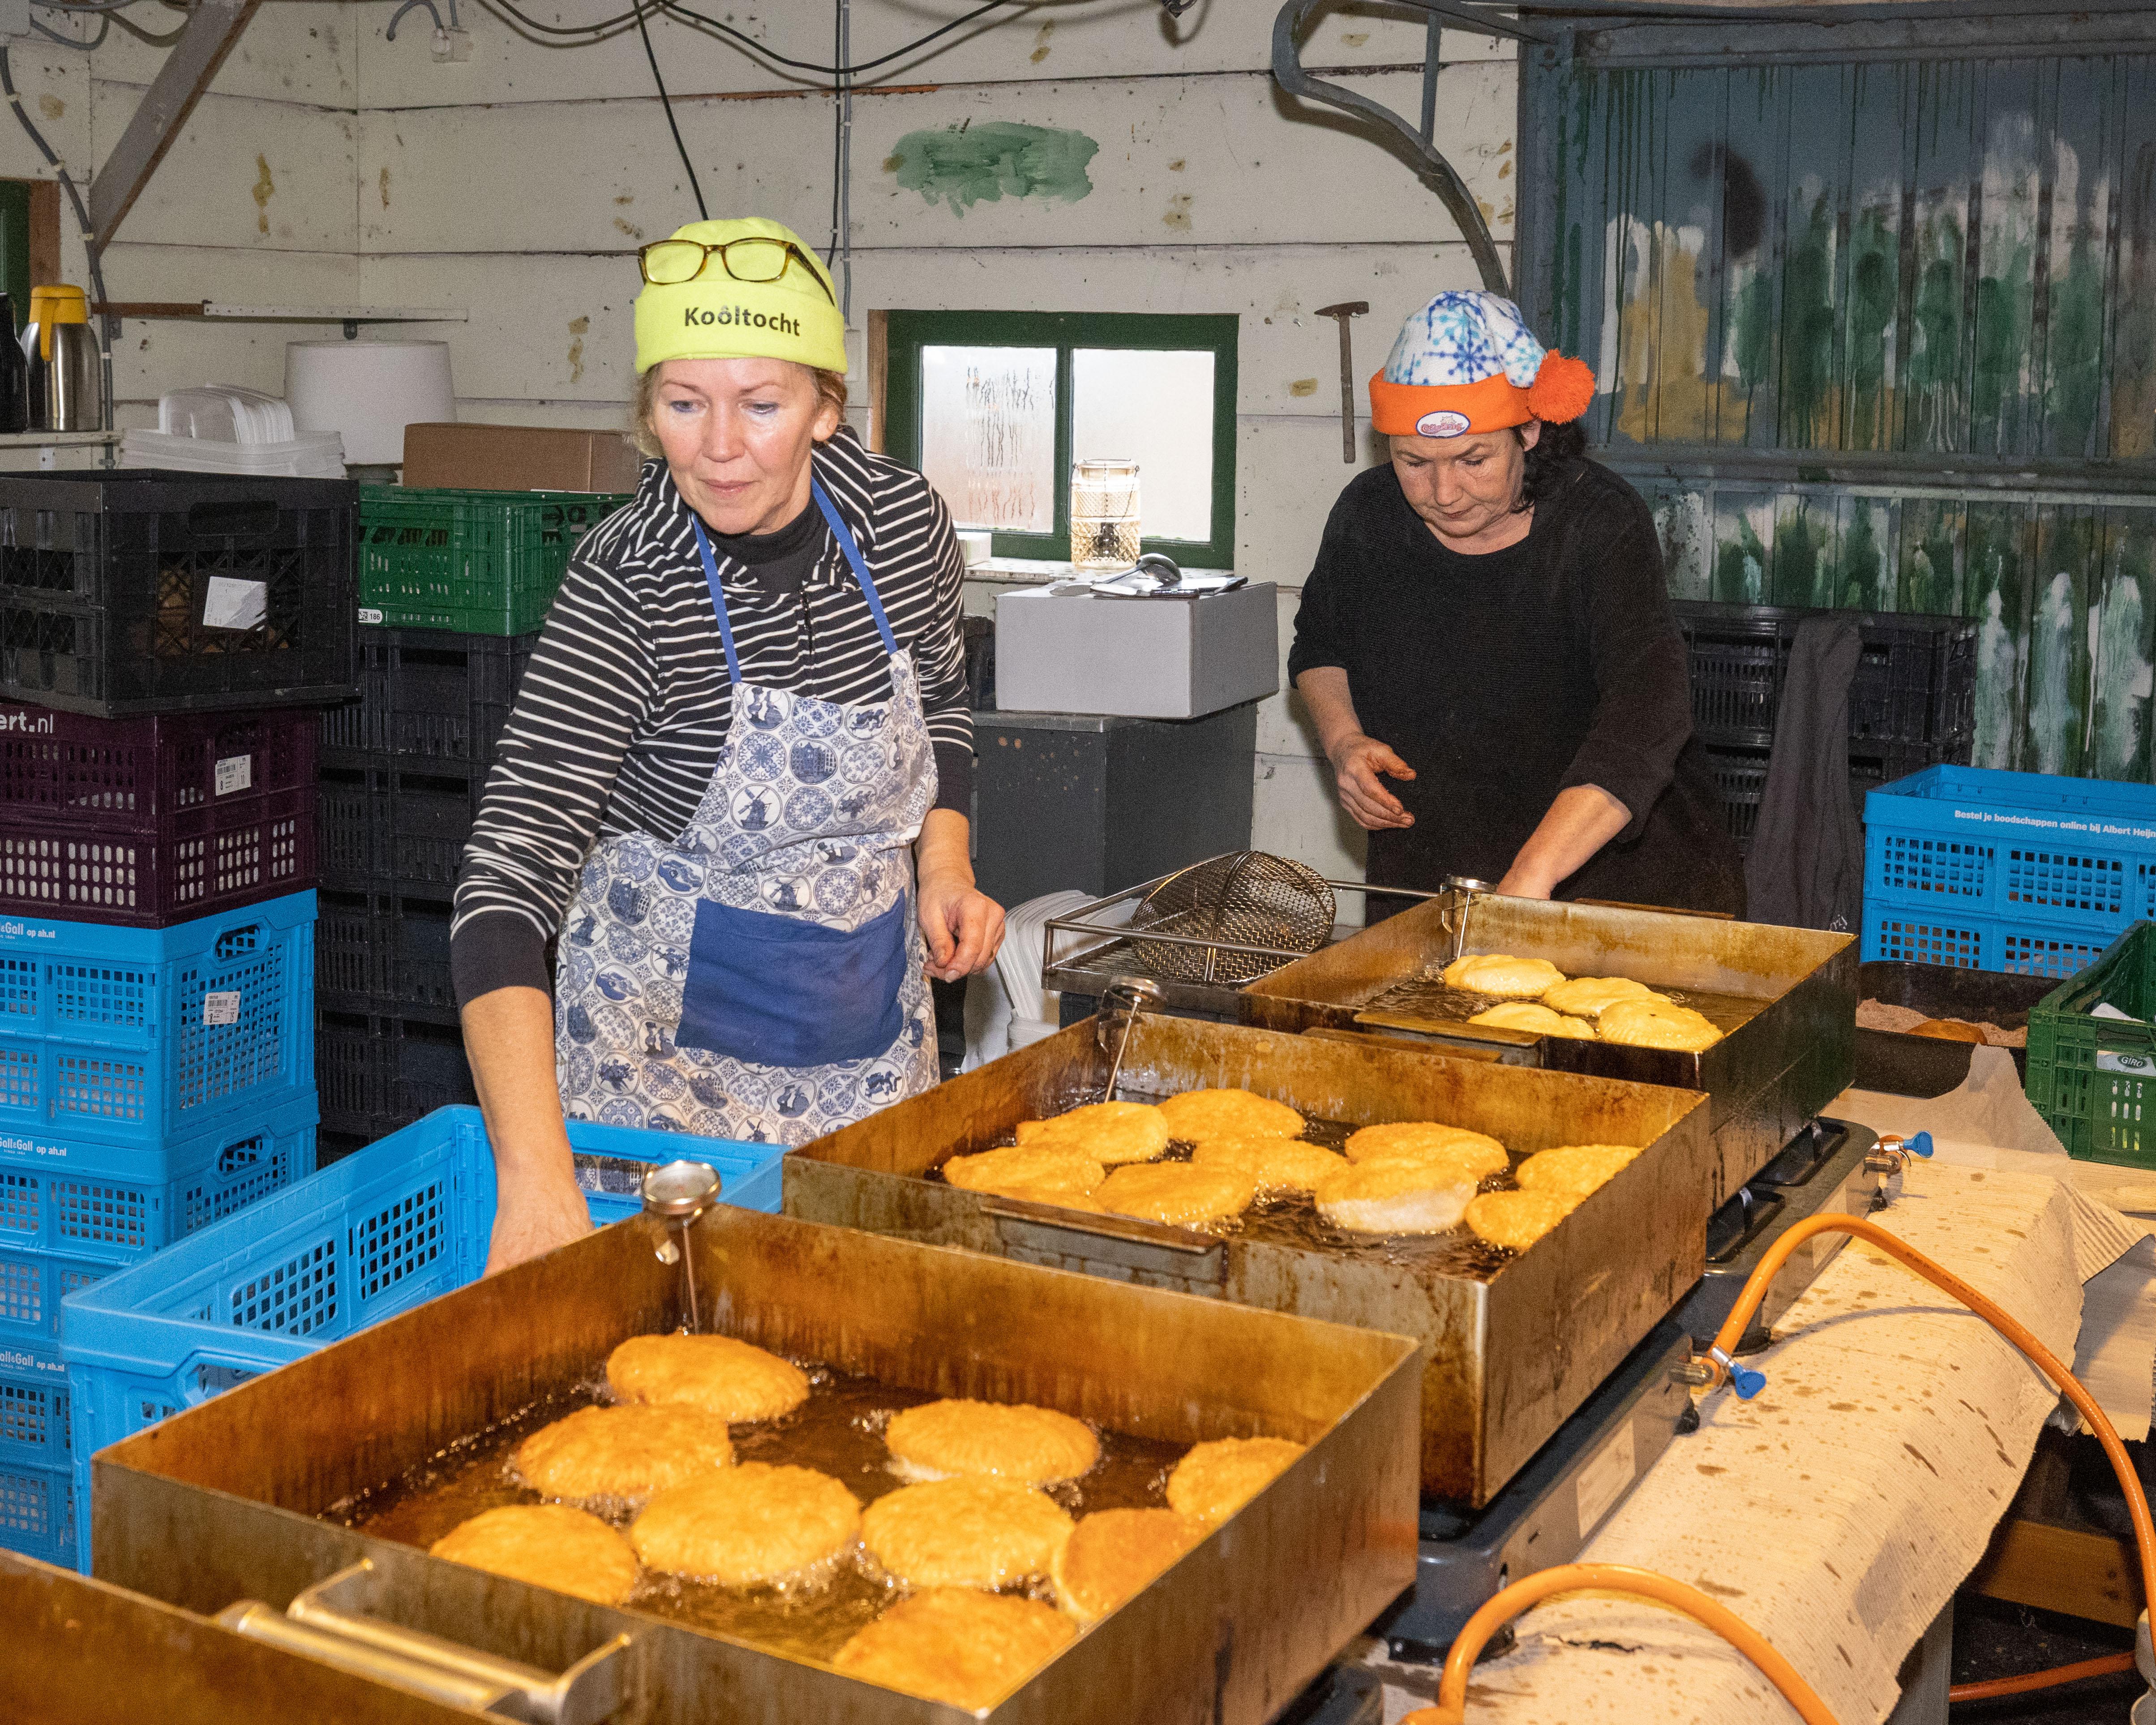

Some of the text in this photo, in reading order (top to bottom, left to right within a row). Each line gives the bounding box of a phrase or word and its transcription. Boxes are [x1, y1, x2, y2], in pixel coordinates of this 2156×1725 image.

[685, 305, 800, 337] Koôltocht
[0, 712, 53, 734] ert.nl
[1955, 810, 2156, 839] Bestel je boodschappen online bij Albert Heijn
[27, 929, 36, 938] op
[38, 929, 55, 939] ah.nl
[2121, 1056, 2143, 1068] GIRO
[36, 1146, 47, 1155] op
[48, 1146, 67, 1156] ah.nl
[37, 1361, 46, 1370] op
[47, 1362, 65, 1372] ah.nl
